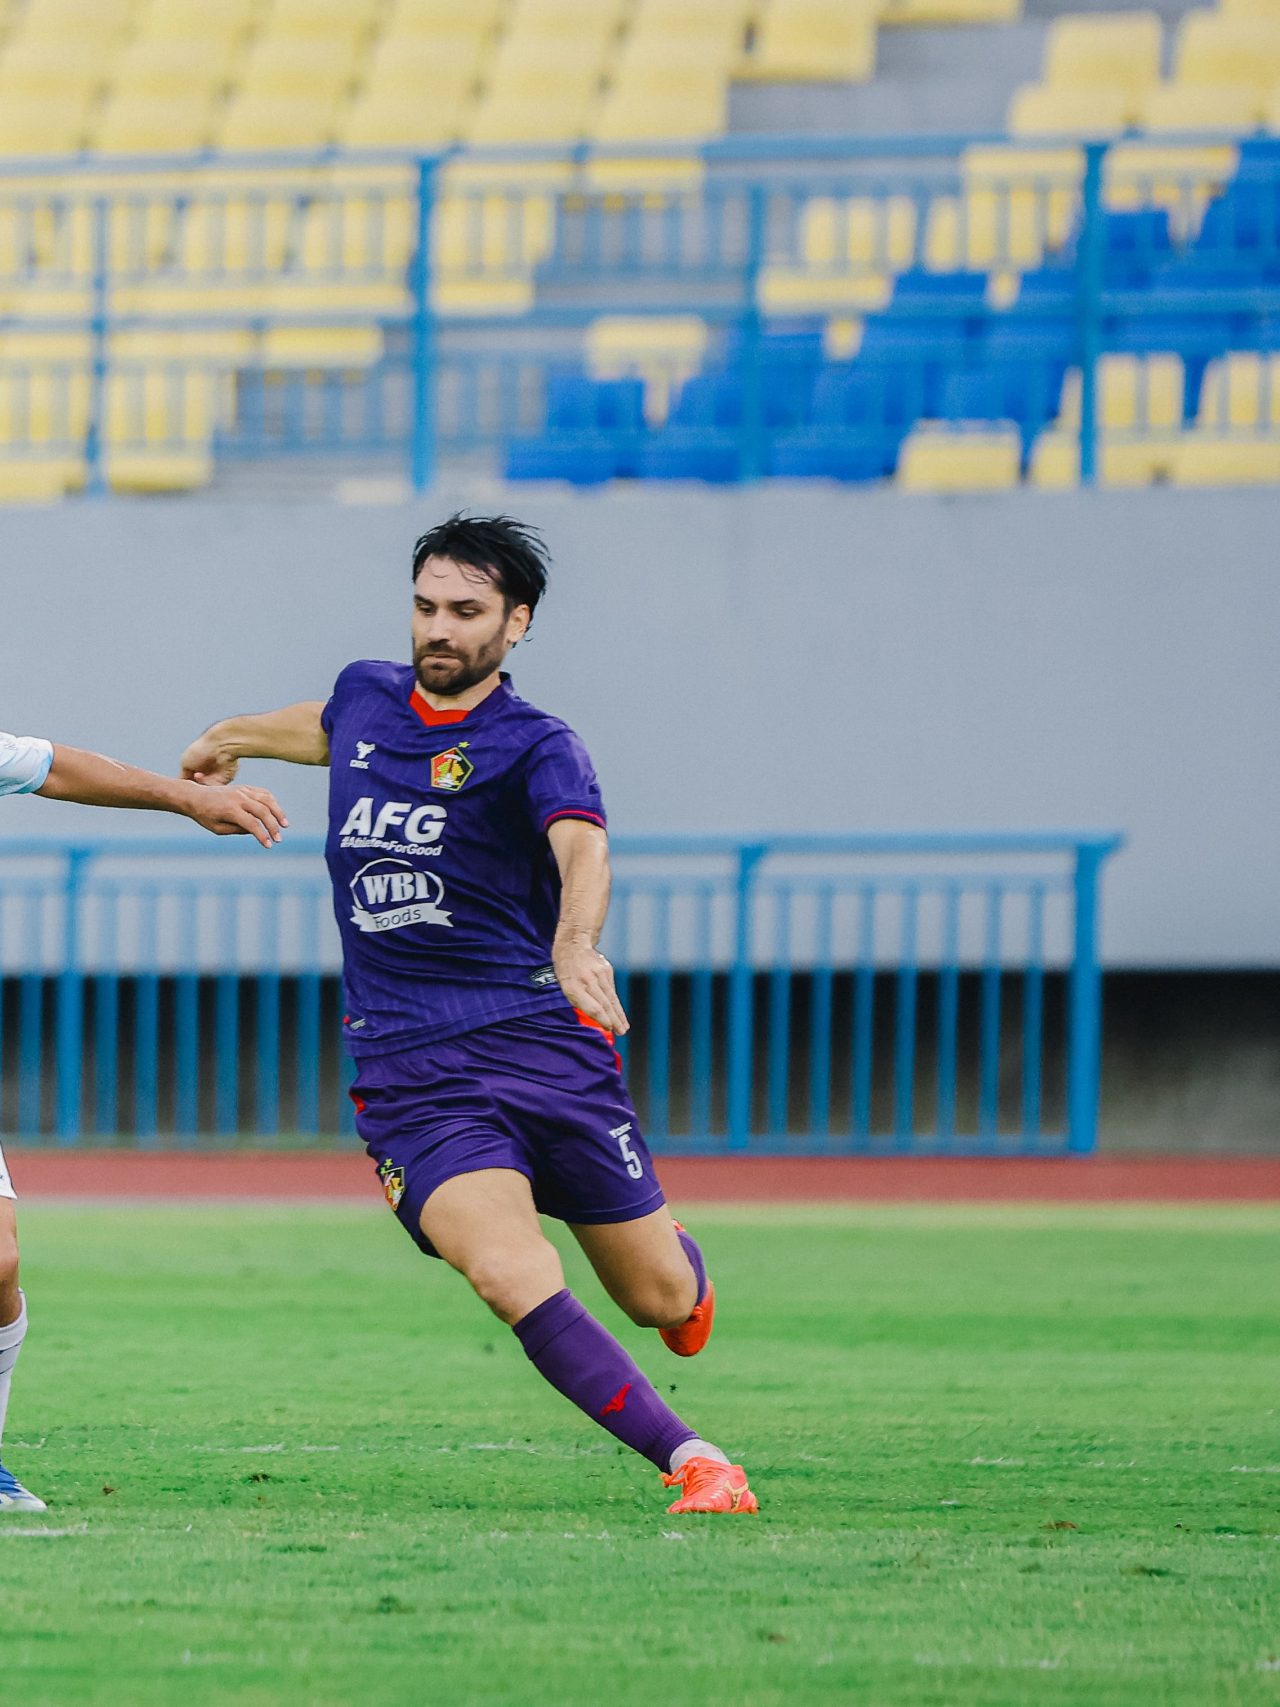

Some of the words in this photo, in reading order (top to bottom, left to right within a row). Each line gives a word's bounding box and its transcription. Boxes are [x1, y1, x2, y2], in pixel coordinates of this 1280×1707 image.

[339, 797, 448, 844] AFG
[361, 871, 431, 905] WBI
[373, 908, 422, 929] Foods
[618, 1133, 644, 1180] 5
